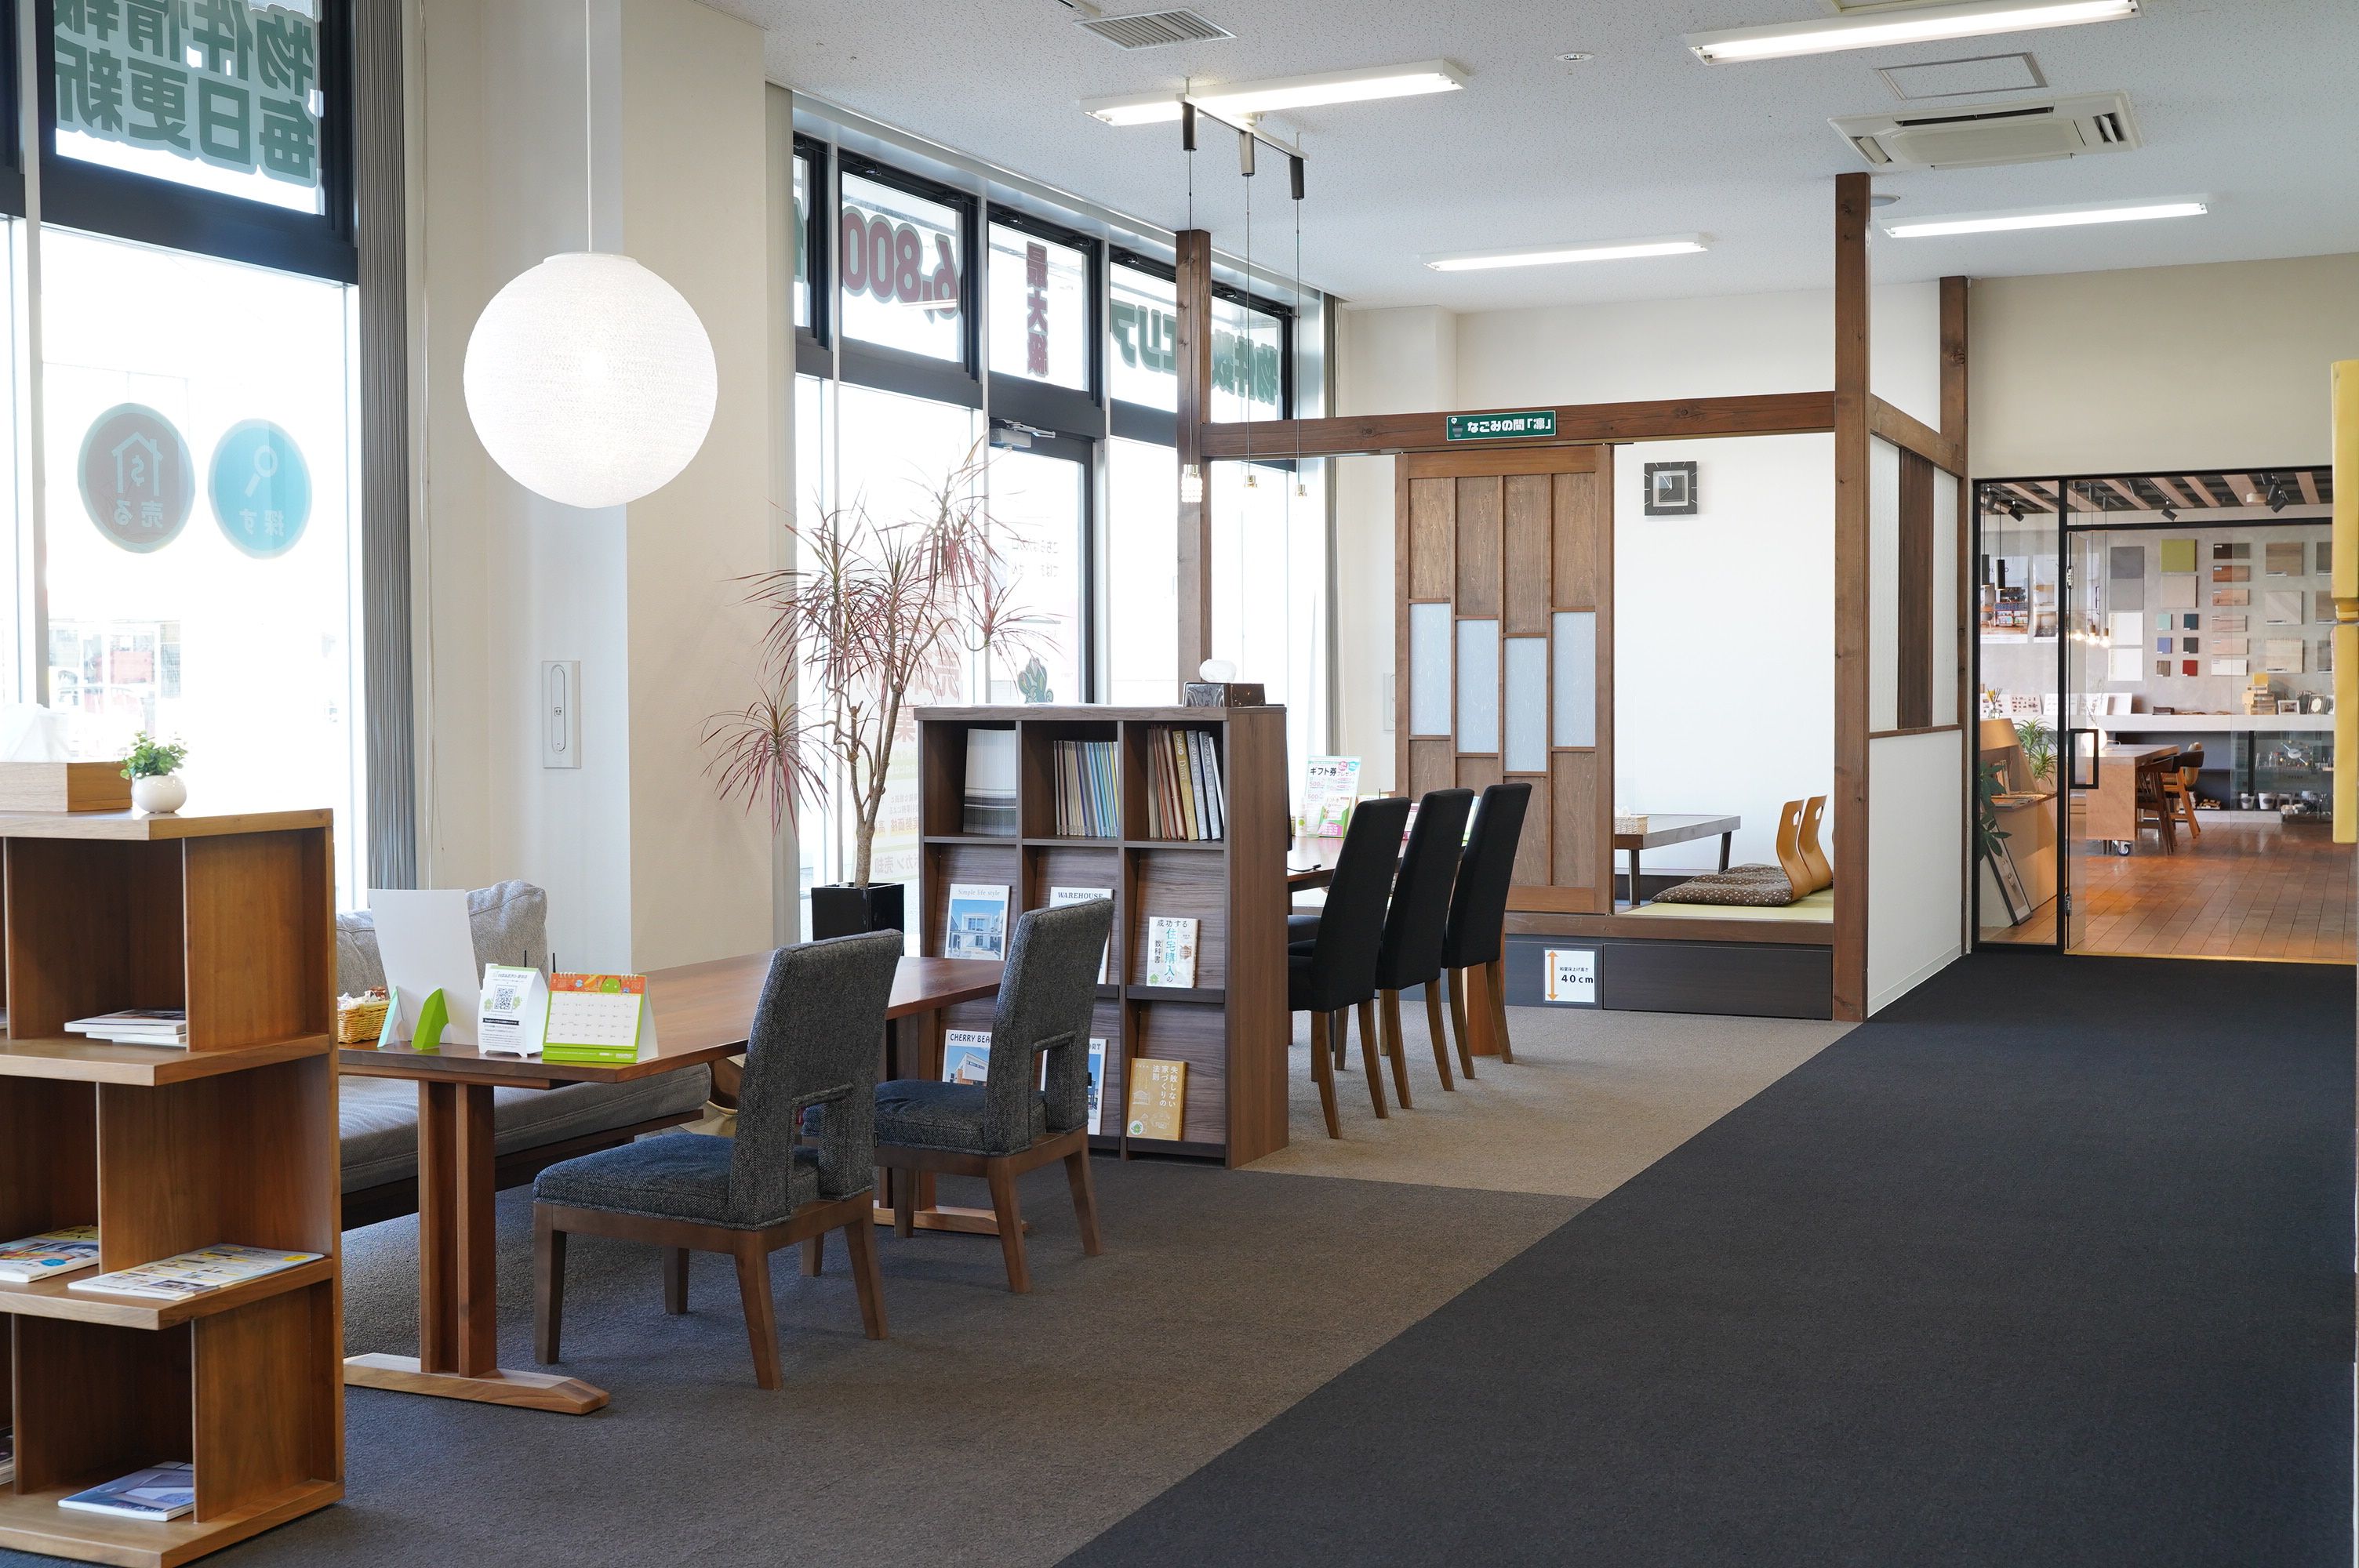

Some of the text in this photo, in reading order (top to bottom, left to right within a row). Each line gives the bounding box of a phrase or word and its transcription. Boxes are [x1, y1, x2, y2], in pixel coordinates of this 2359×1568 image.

[1190, 735, 1199, 765] KOIZUMI
[1310, 768, 1336, 776] ギフト券
[1157, 919, 1188, 927] 成功する
[950, 1033, 975, 1042] CHERRY
[1152, 1065, 1160, 1081] 法則
[1160, 1065, 1169, 1107] 家づくりの
[1169, 1065, 1179, 1107] 失敗しない
